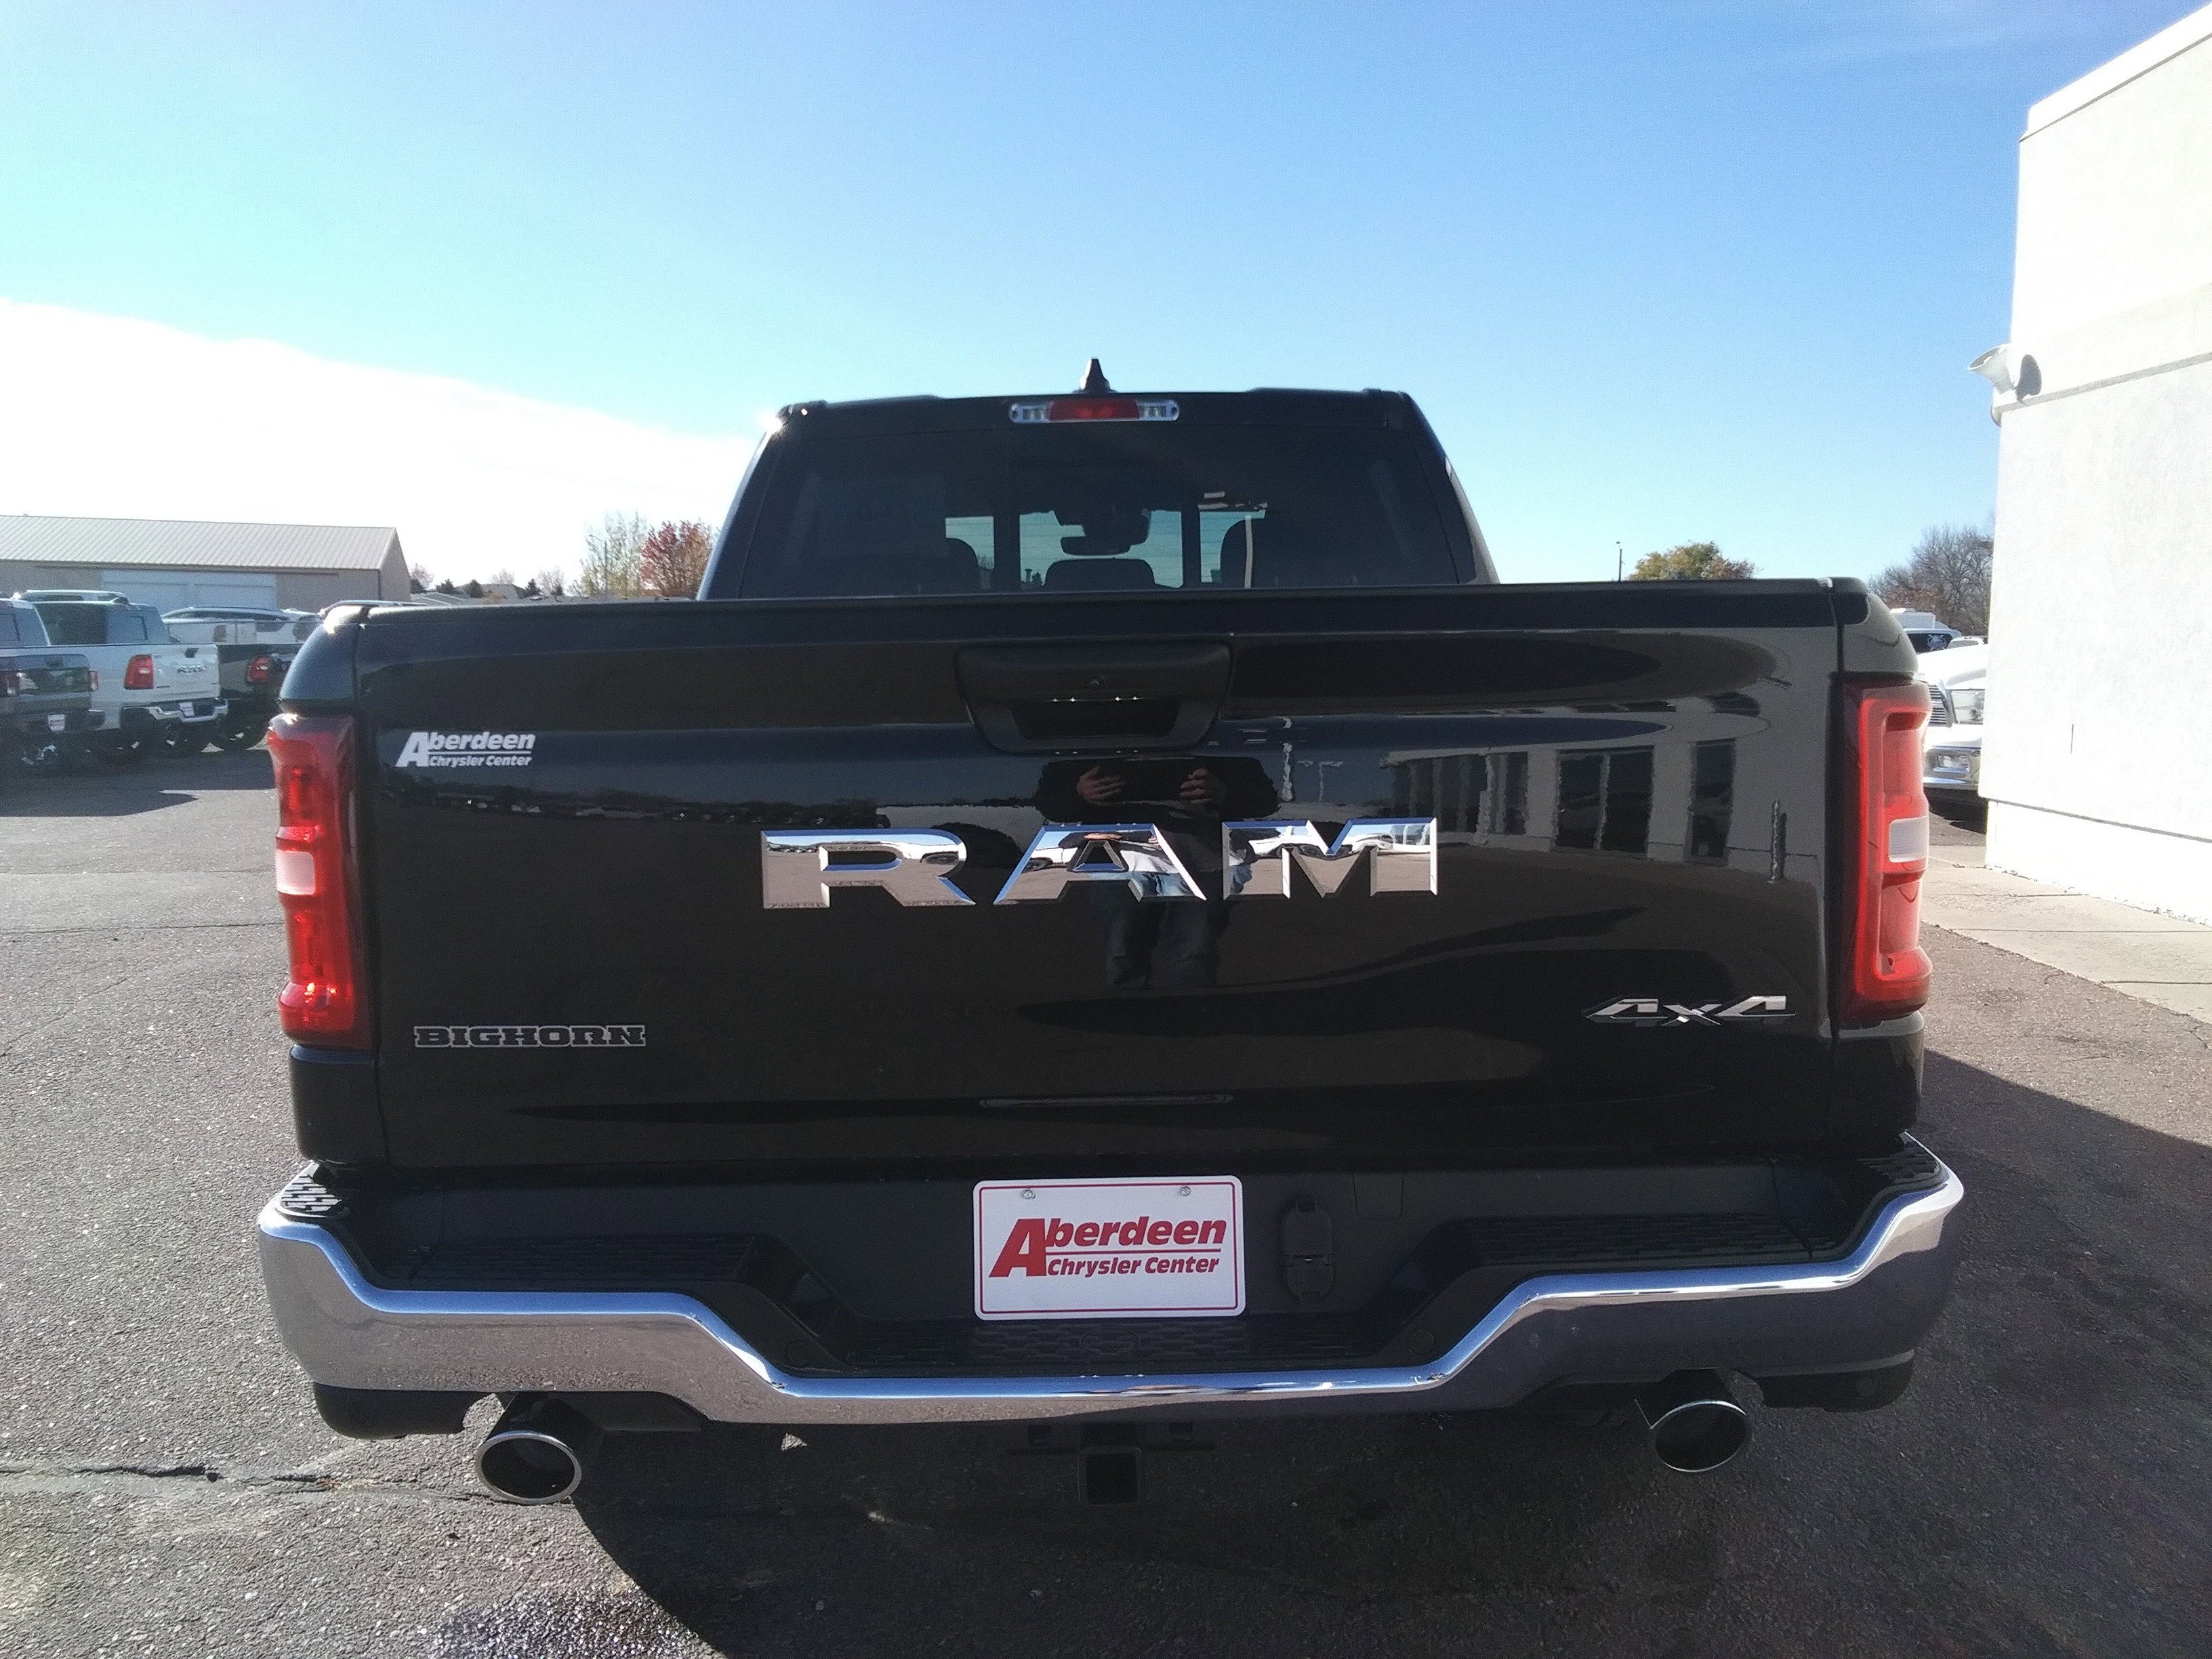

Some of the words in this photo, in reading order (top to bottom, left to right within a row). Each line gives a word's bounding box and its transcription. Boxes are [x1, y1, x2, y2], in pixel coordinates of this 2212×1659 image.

[394, 731, 536, 767] Aberdeen
[429, 755, 485, 768] Chrysler
[485, 755, 533, 766] Center
[760, 817, 1437, 909] RAM
[988, 1216, 1227, 1277] Aberdeen
[1047, 1257, 1142, 1278] Chrysler
[1144, 1256, 1220, 1274] Center
